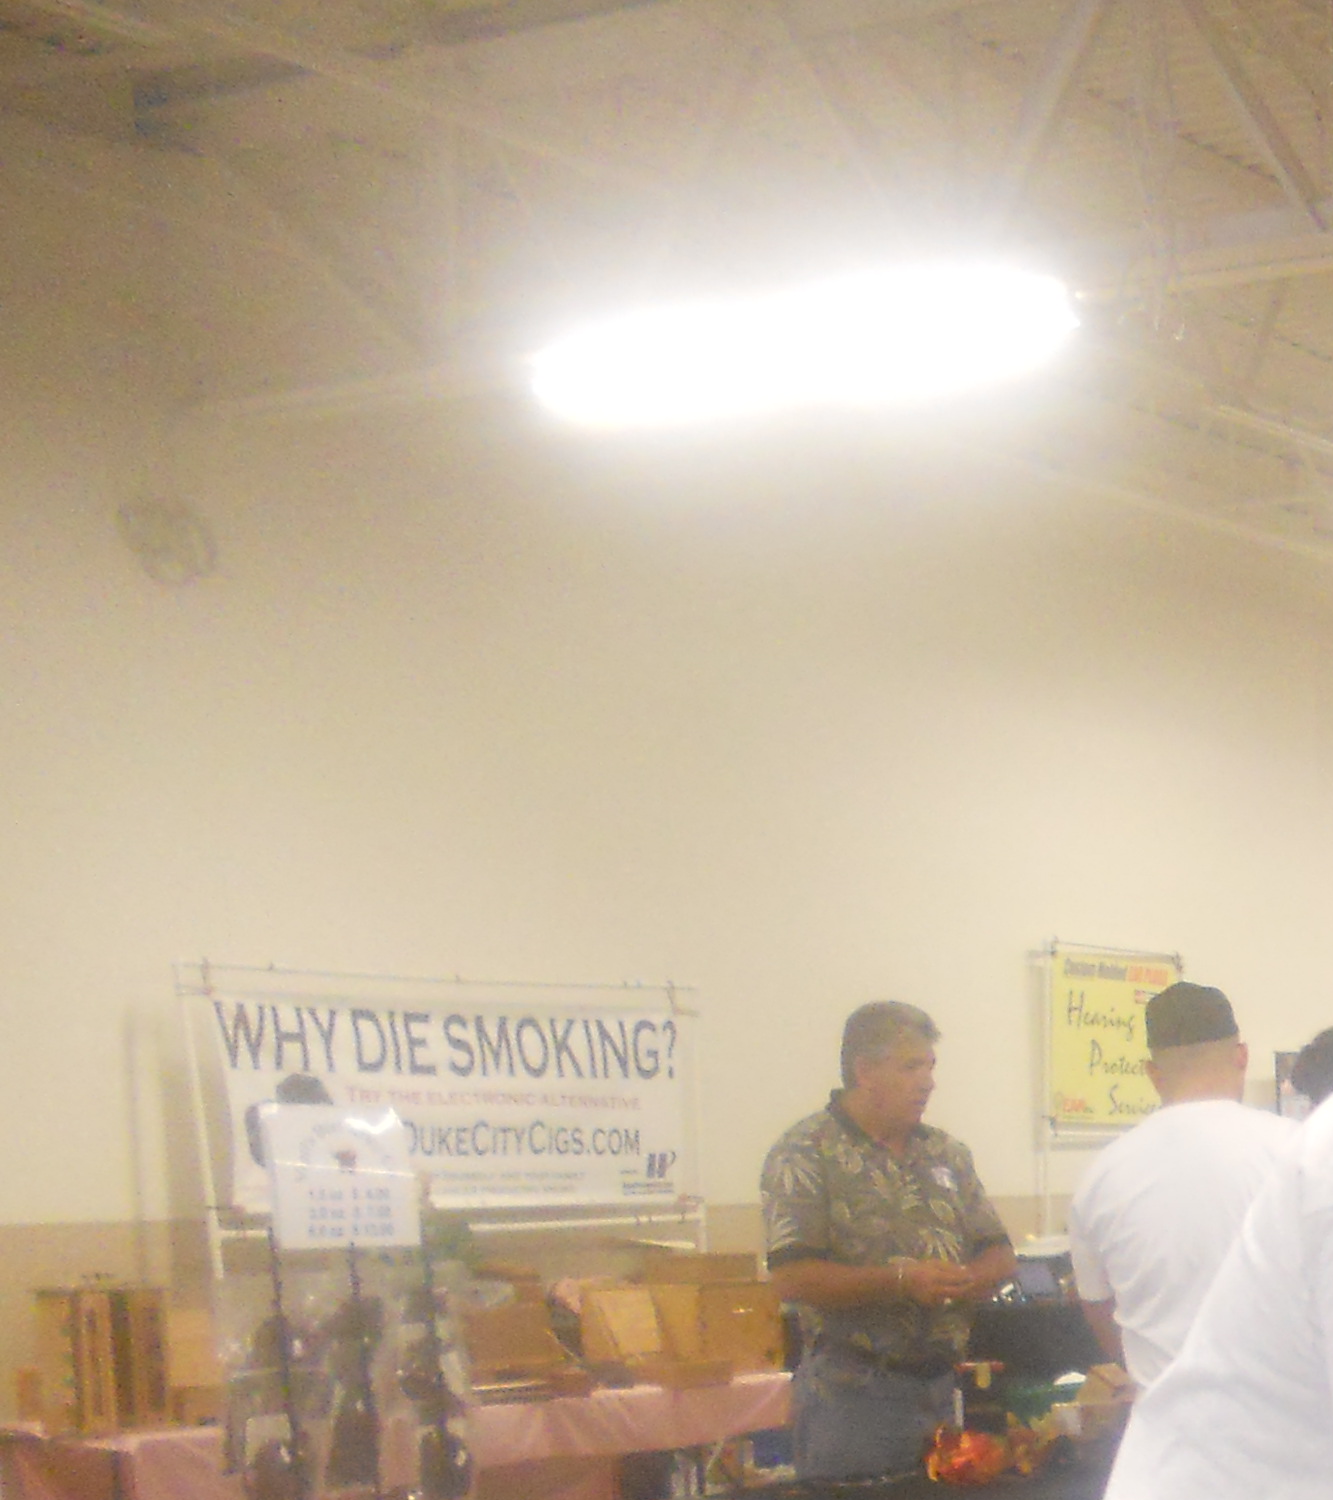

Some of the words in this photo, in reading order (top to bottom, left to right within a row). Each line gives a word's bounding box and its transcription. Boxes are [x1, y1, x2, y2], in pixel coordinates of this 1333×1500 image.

[213, 1001, 336, 1072] WHY
[351, 1008, 438, 1075] DIE
[442, 1013, 677, 1080] SMOKING?
[1067, 989, 1135, 1042] Hearing
